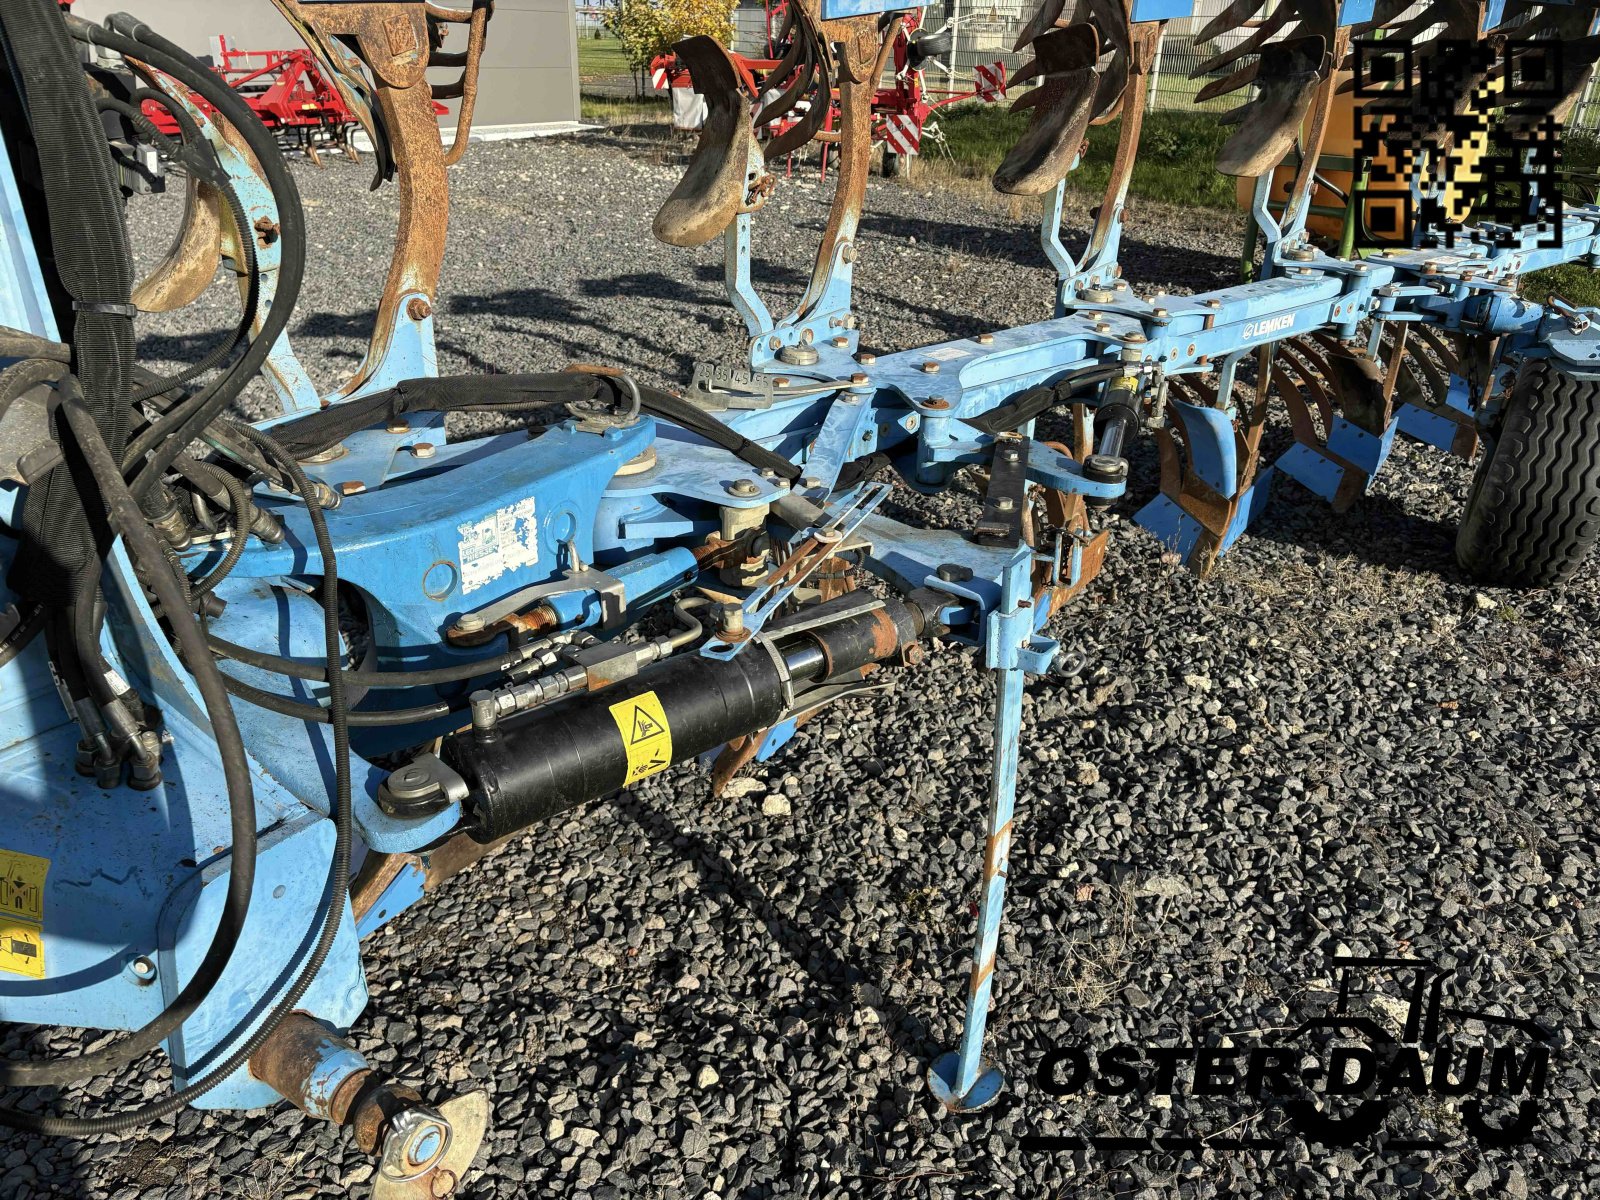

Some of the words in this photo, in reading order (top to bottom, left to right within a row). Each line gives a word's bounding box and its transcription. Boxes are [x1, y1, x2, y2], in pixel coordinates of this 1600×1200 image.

[1253, 313, 1296, 336] LEMKEN
[699, 363, 710, 378] 25
[734, 371, 748, 385] 45
